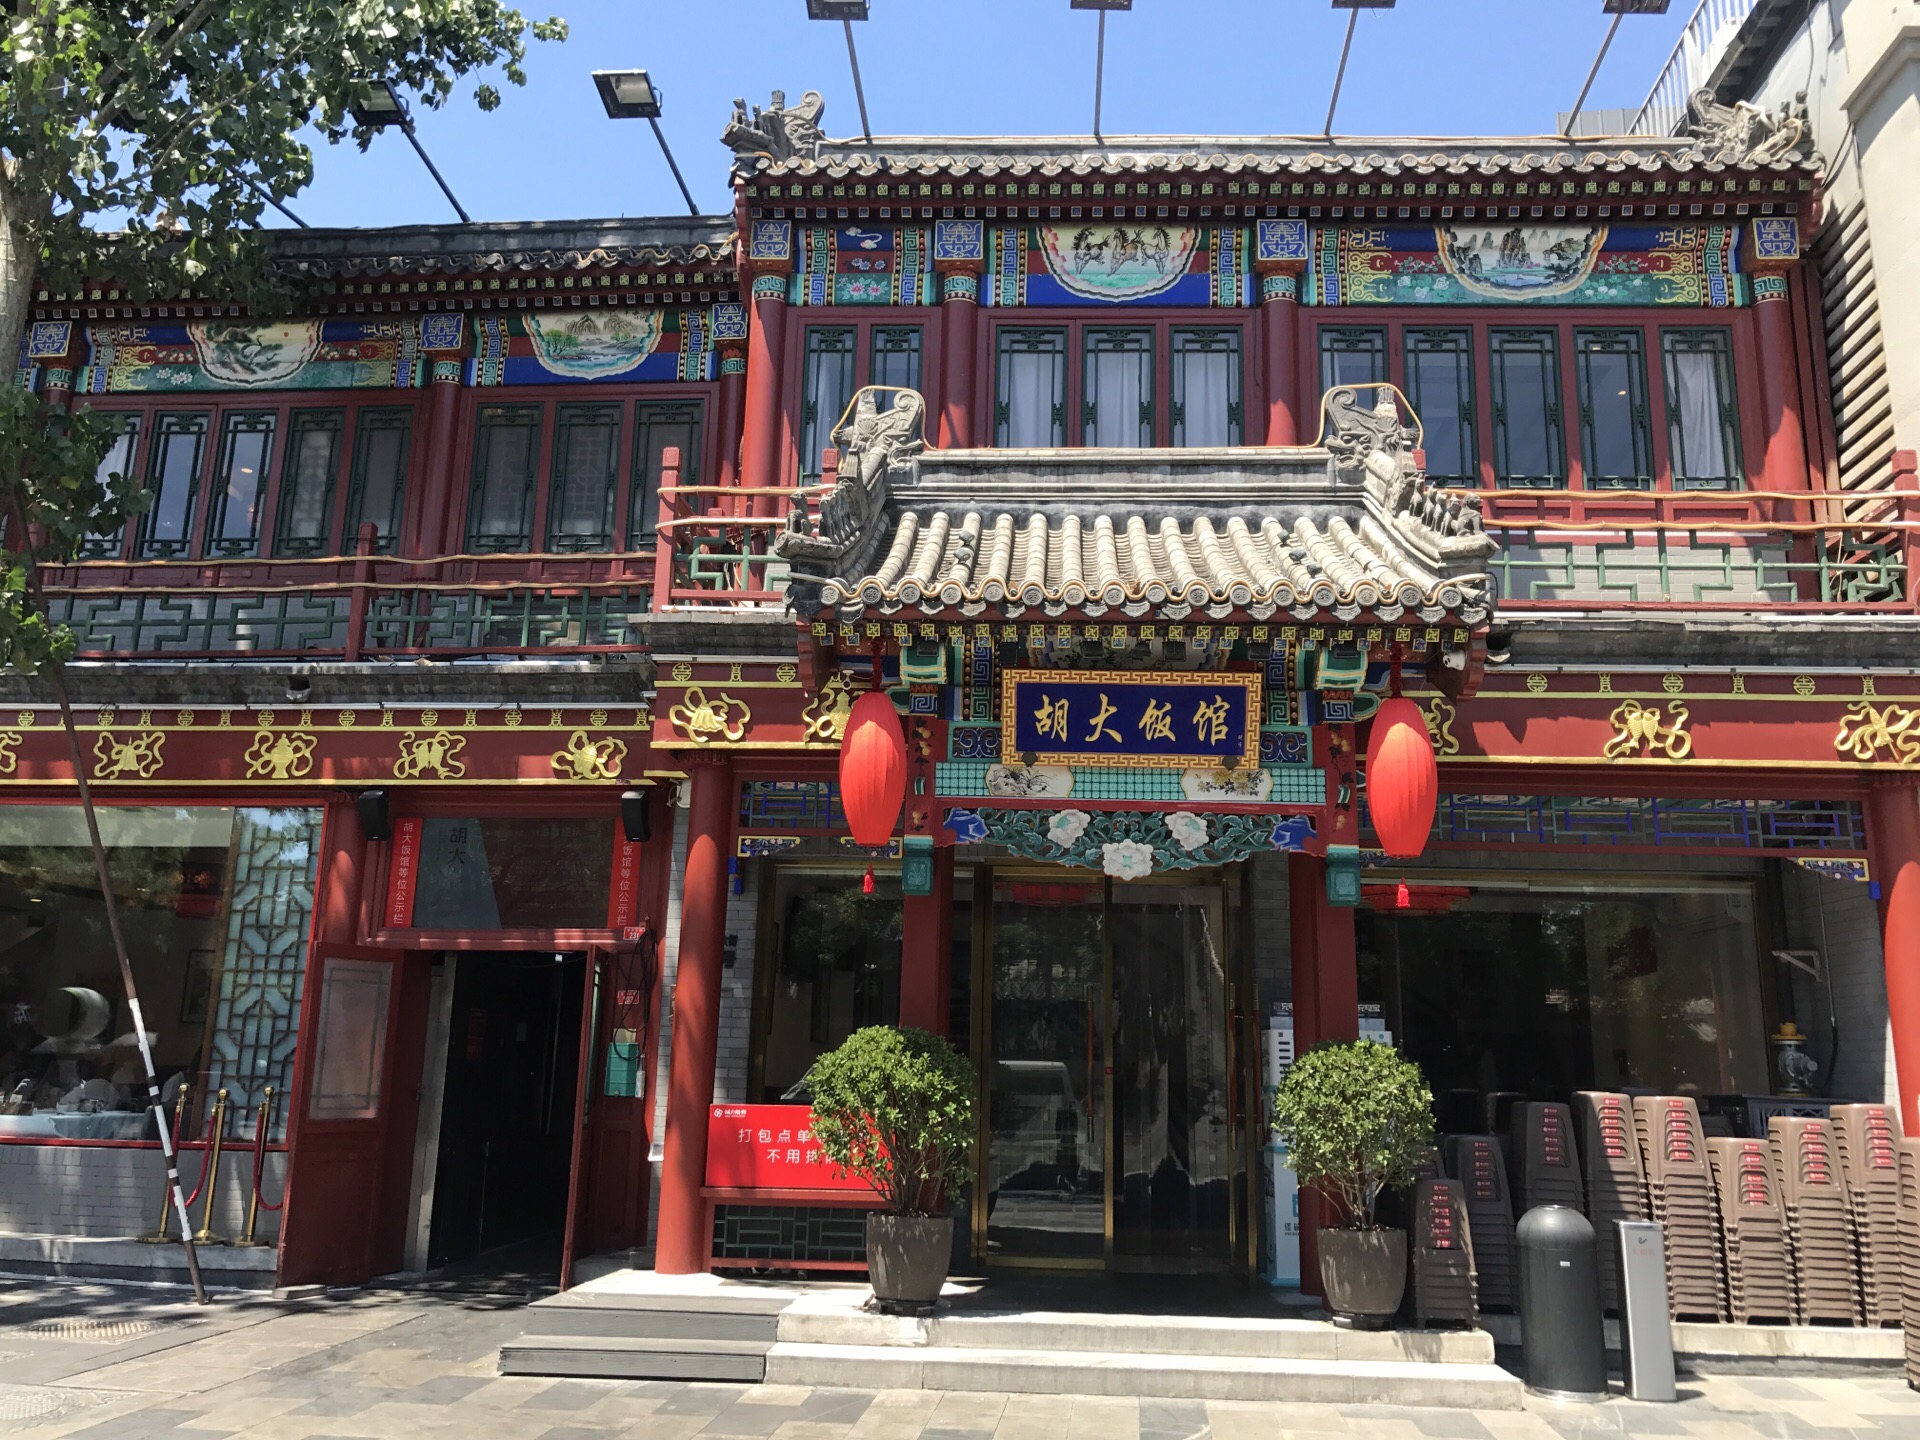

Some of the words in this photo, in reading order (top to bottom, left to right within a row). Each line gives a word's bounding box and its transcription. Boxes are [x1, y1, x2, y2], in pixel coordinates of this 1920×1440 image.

[1033, 692, 1231, 746] 胡大饭馆
[393, 822, 414, 924] 胡大饭馆等位公示栏
[447, 827, 468, 865] 胡大
[616, 835, 634, 926] 饭馆等位公示栏
[738, 1128, 823, 1144] 打包点单
